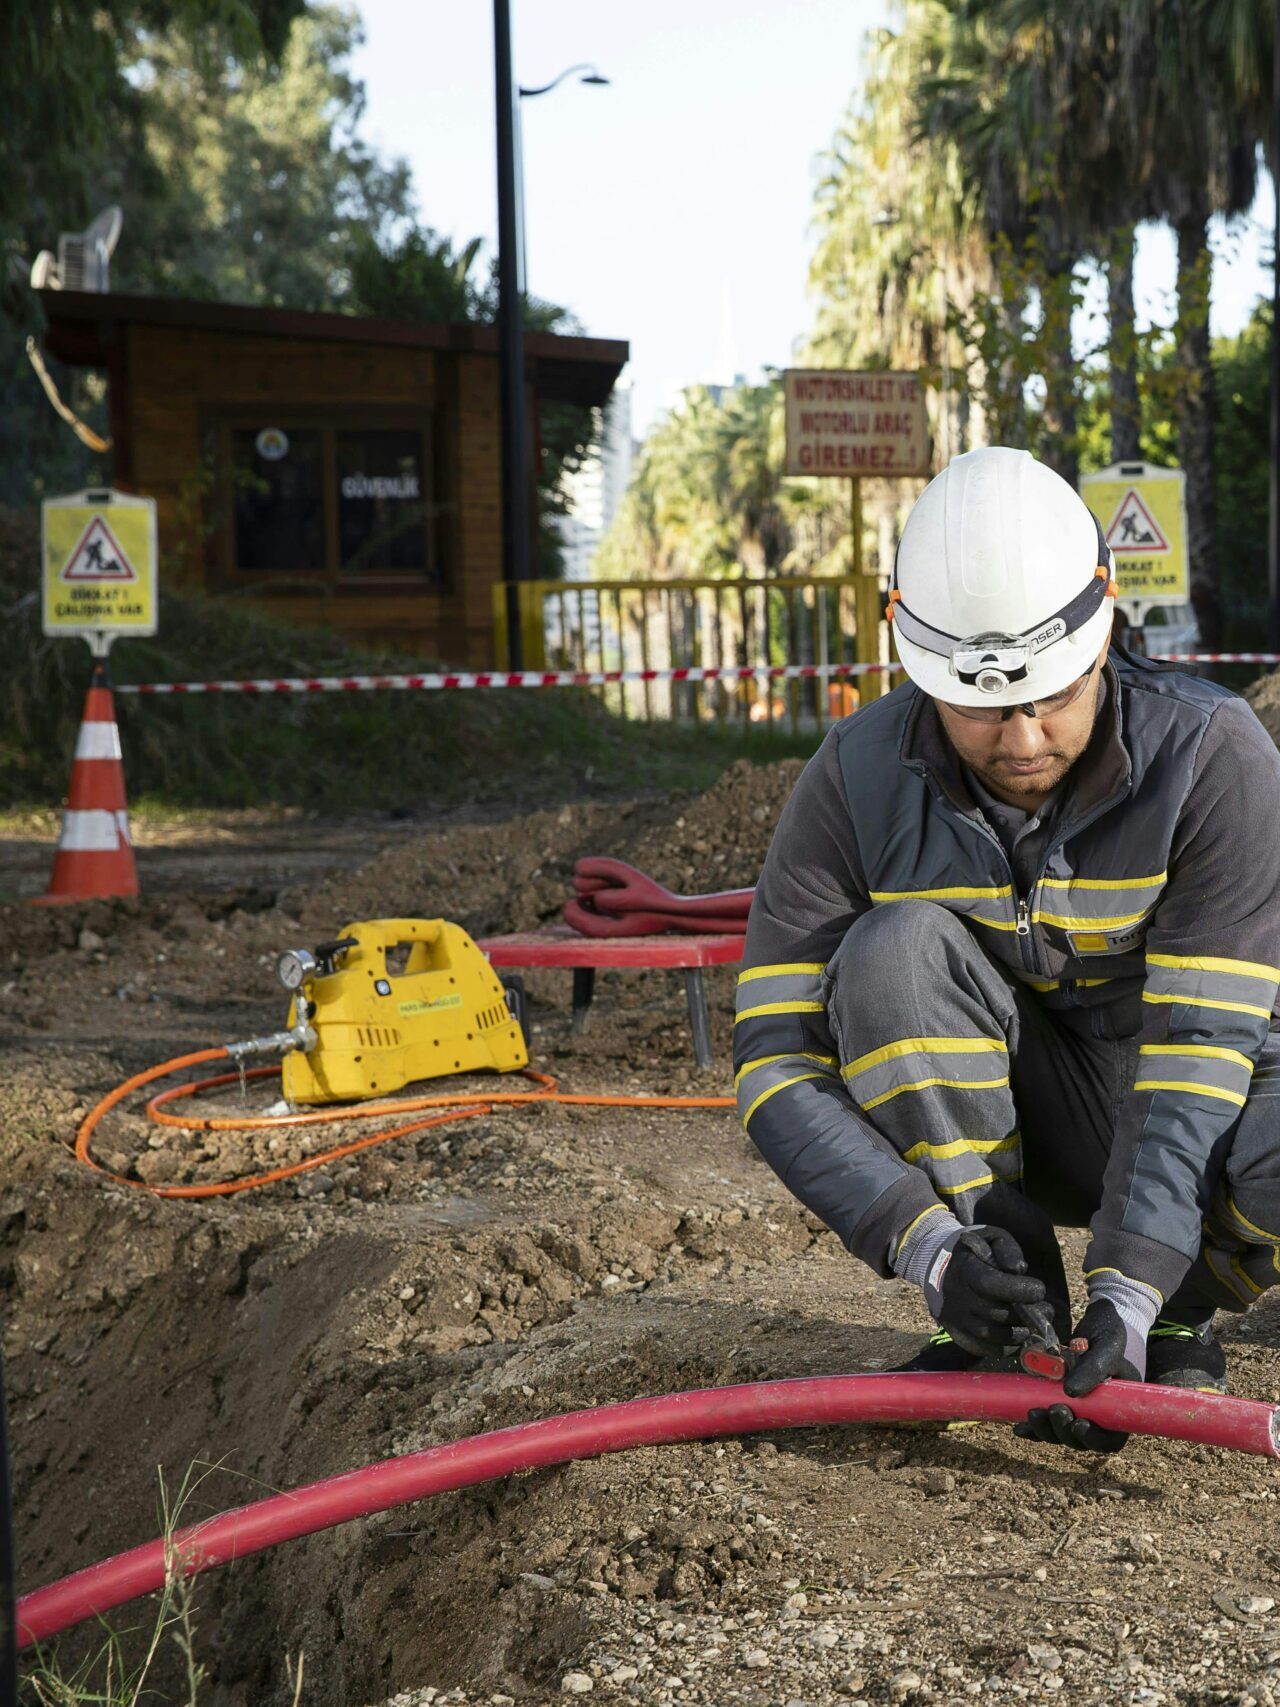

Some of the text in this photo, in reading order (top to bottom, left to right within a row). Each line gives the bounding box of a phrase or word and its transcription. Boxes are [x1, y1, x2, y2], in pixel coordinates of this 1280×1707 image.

[1116, 560, 1152, 571] İKKAT
[1153, 576, 1176, 586] VAR
[1031, 623, 1062, 647] NSER
